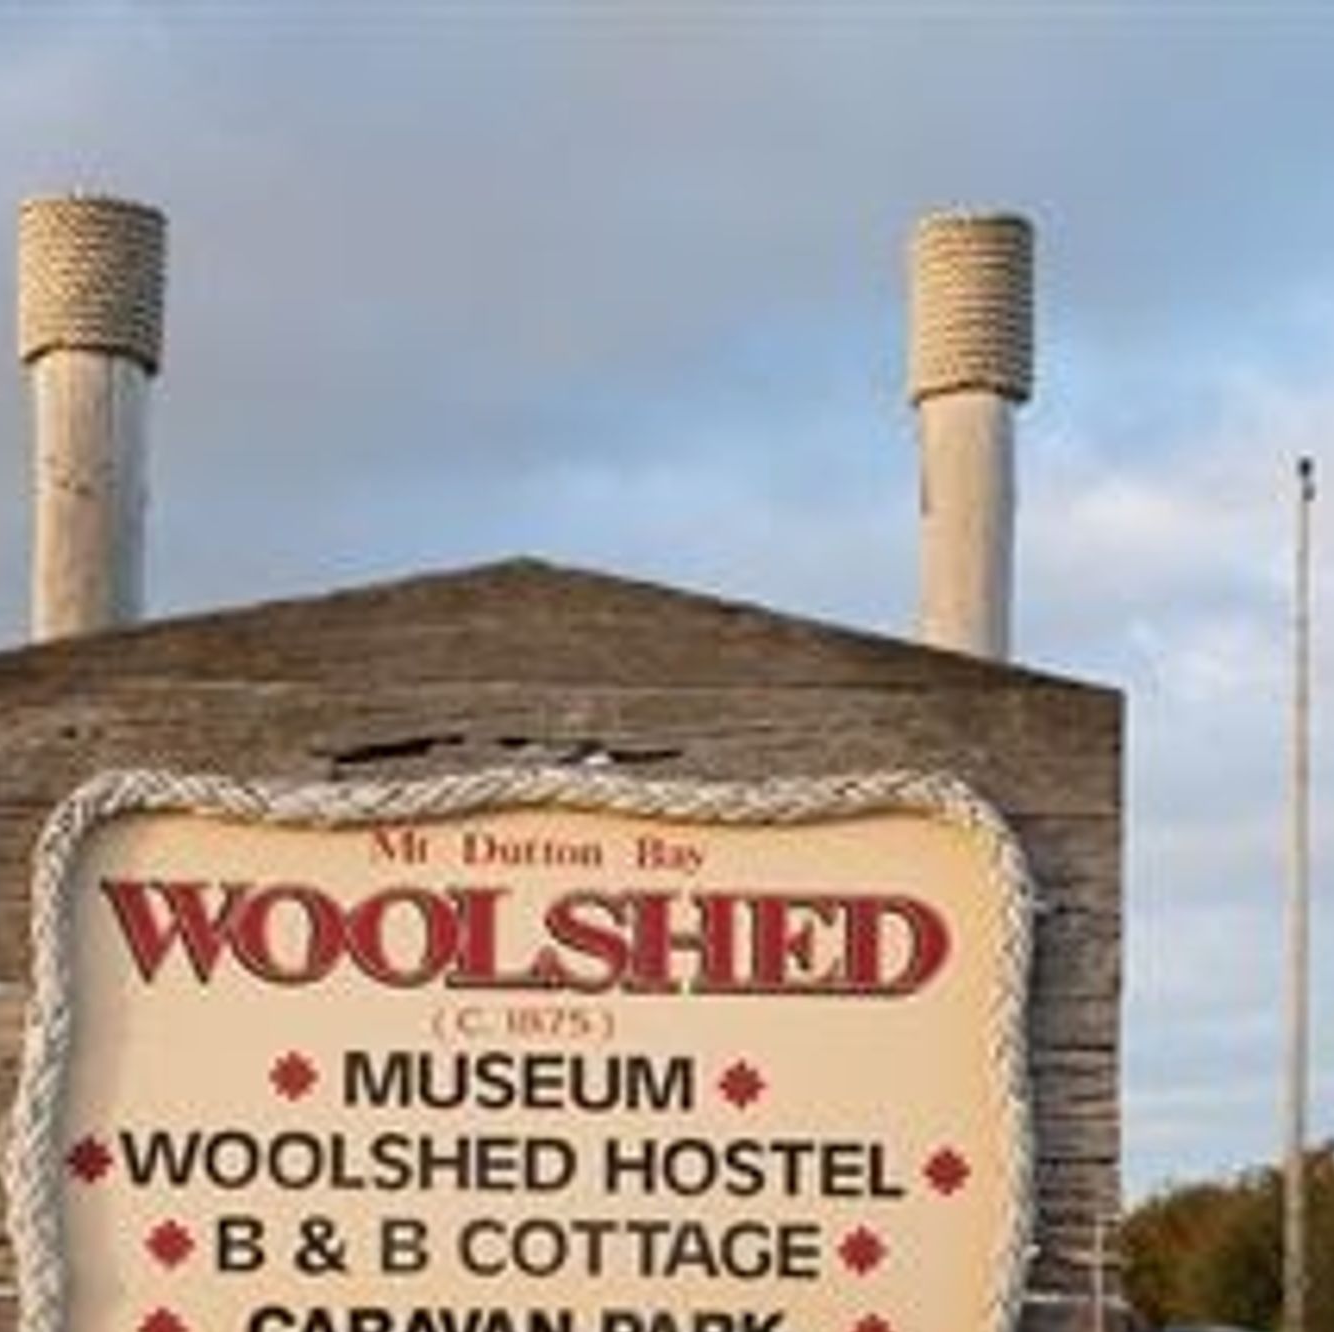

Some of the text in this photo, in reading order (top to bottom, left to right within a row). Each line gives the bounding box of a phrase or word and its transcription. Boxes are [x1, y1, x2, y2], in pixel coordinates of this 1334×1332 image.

[371, 829, 705, 875] Mt Dutton Bay
[101, 877, 952, 1001] WOOLSHED
[343, 1053, 697, 1113] MUSEUM
[119, 1130, 906, 1200] WOOLSHED HOSTEL
[216, 1218, 822, 1280] B & B COTTAGE
